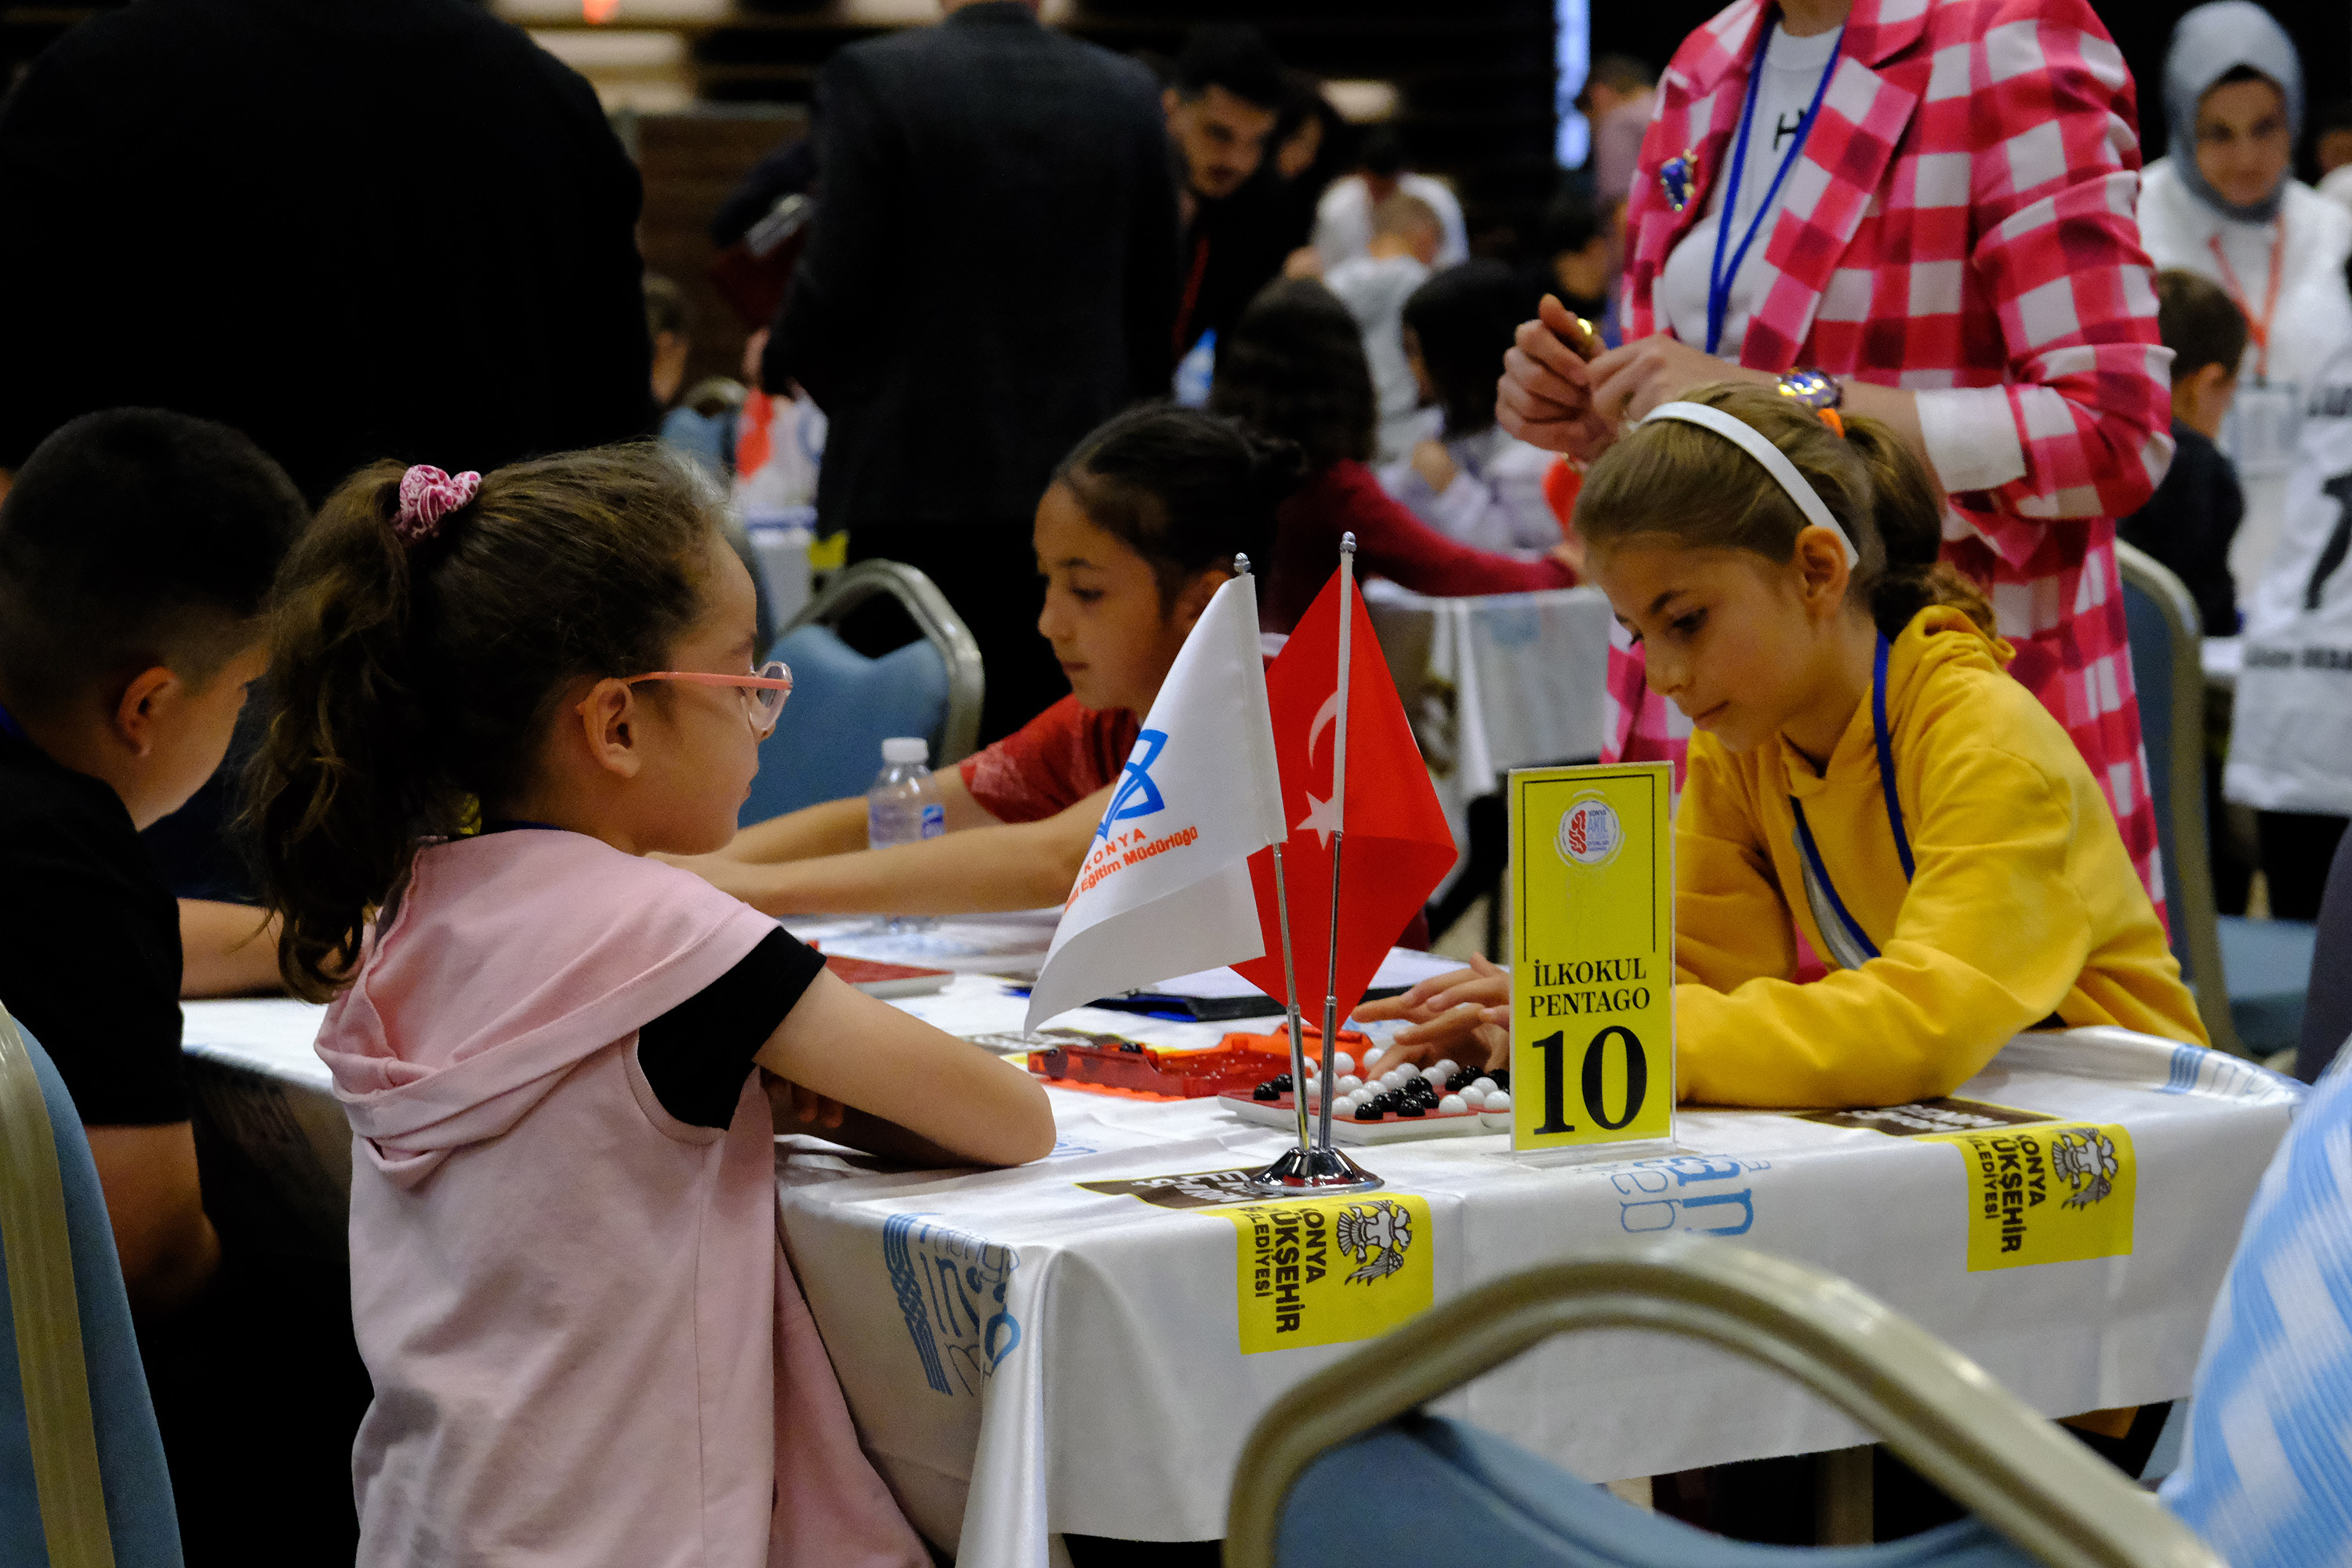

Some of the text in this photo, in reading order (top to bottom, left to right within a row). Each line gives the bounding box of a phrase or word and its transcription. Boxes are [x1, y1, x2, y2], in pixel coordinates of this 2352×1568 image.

[1122, 826, 1200, 867] Müdürlüğü
[1534, 958, 1647, 987] İLKOKUL
[1530, 986, 1650, 1018] PENTAGO
[1532, 1025, 1647, 1135] 10
